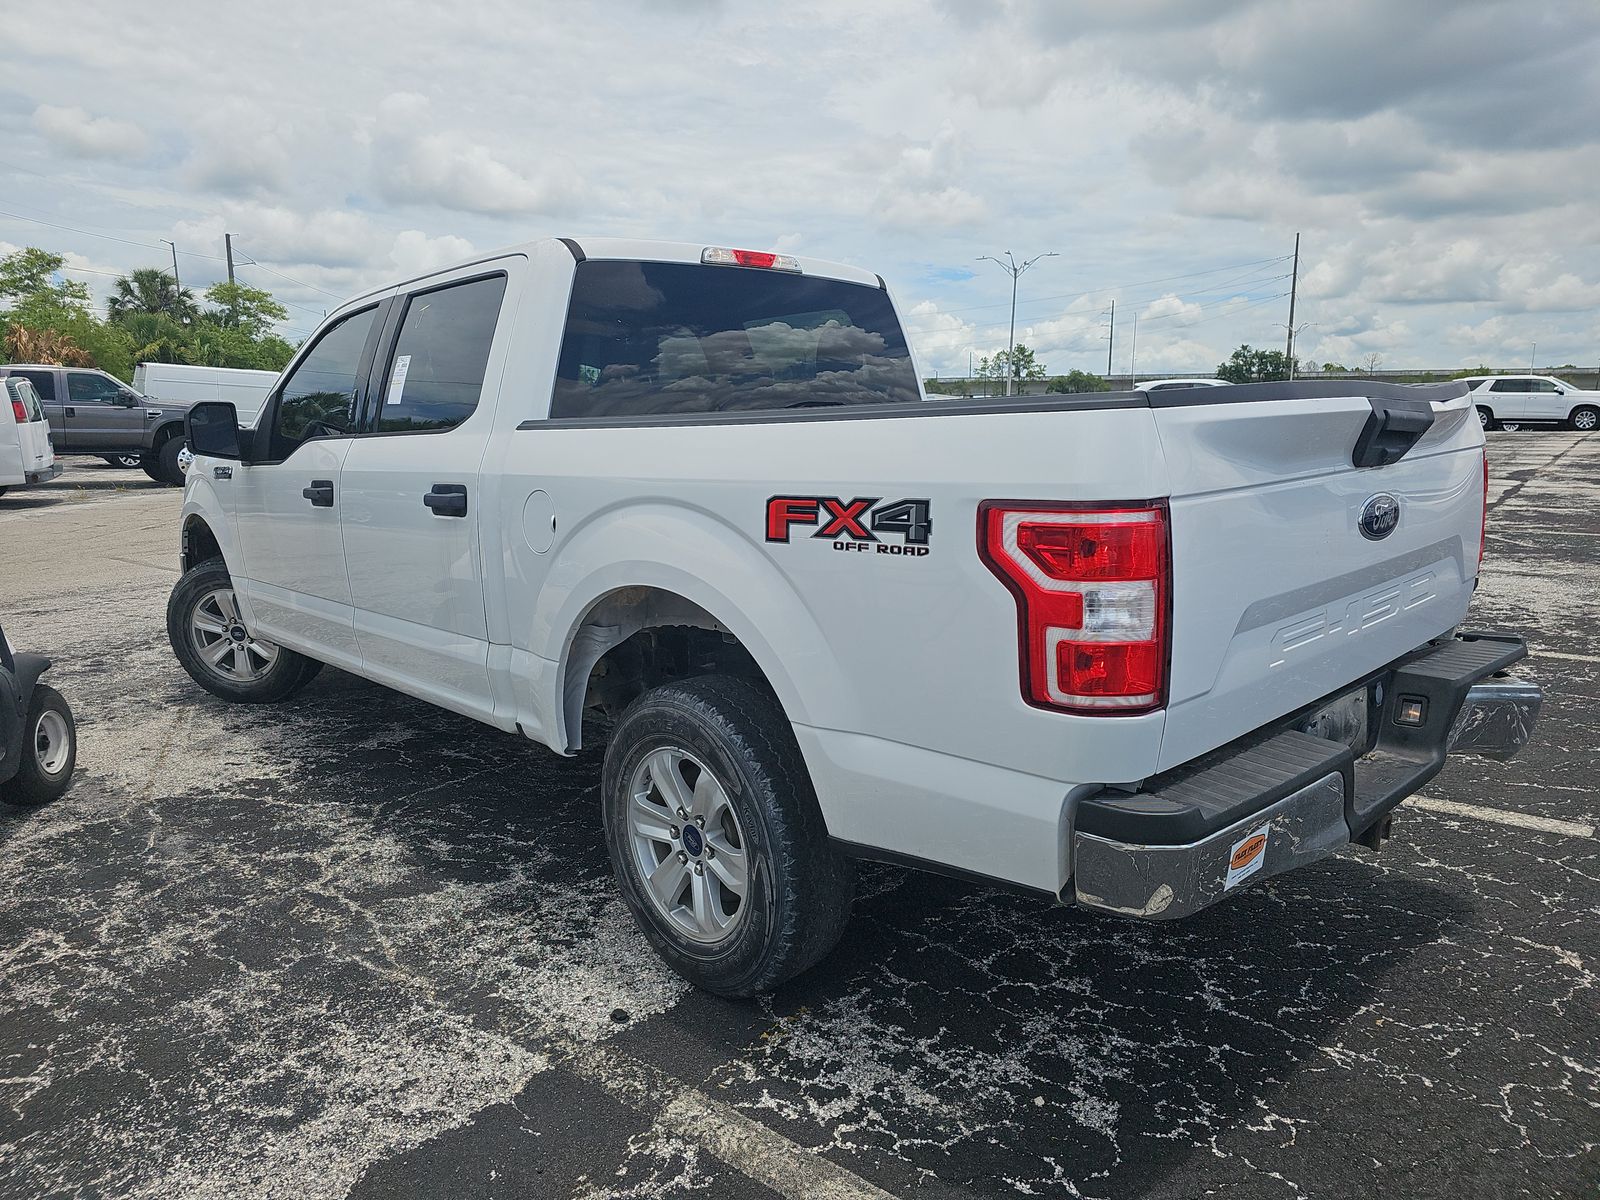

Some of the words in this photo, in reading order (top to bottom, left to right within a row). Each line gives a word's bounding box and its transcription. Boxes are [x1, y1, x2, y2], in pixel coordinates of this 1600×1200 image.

[766, 495, 931, 544] FX4
[1372, 503, 1396, 531] Ford
[833, 541, 870, 552] OFF
[876, 543, 930, 557] ROAD
